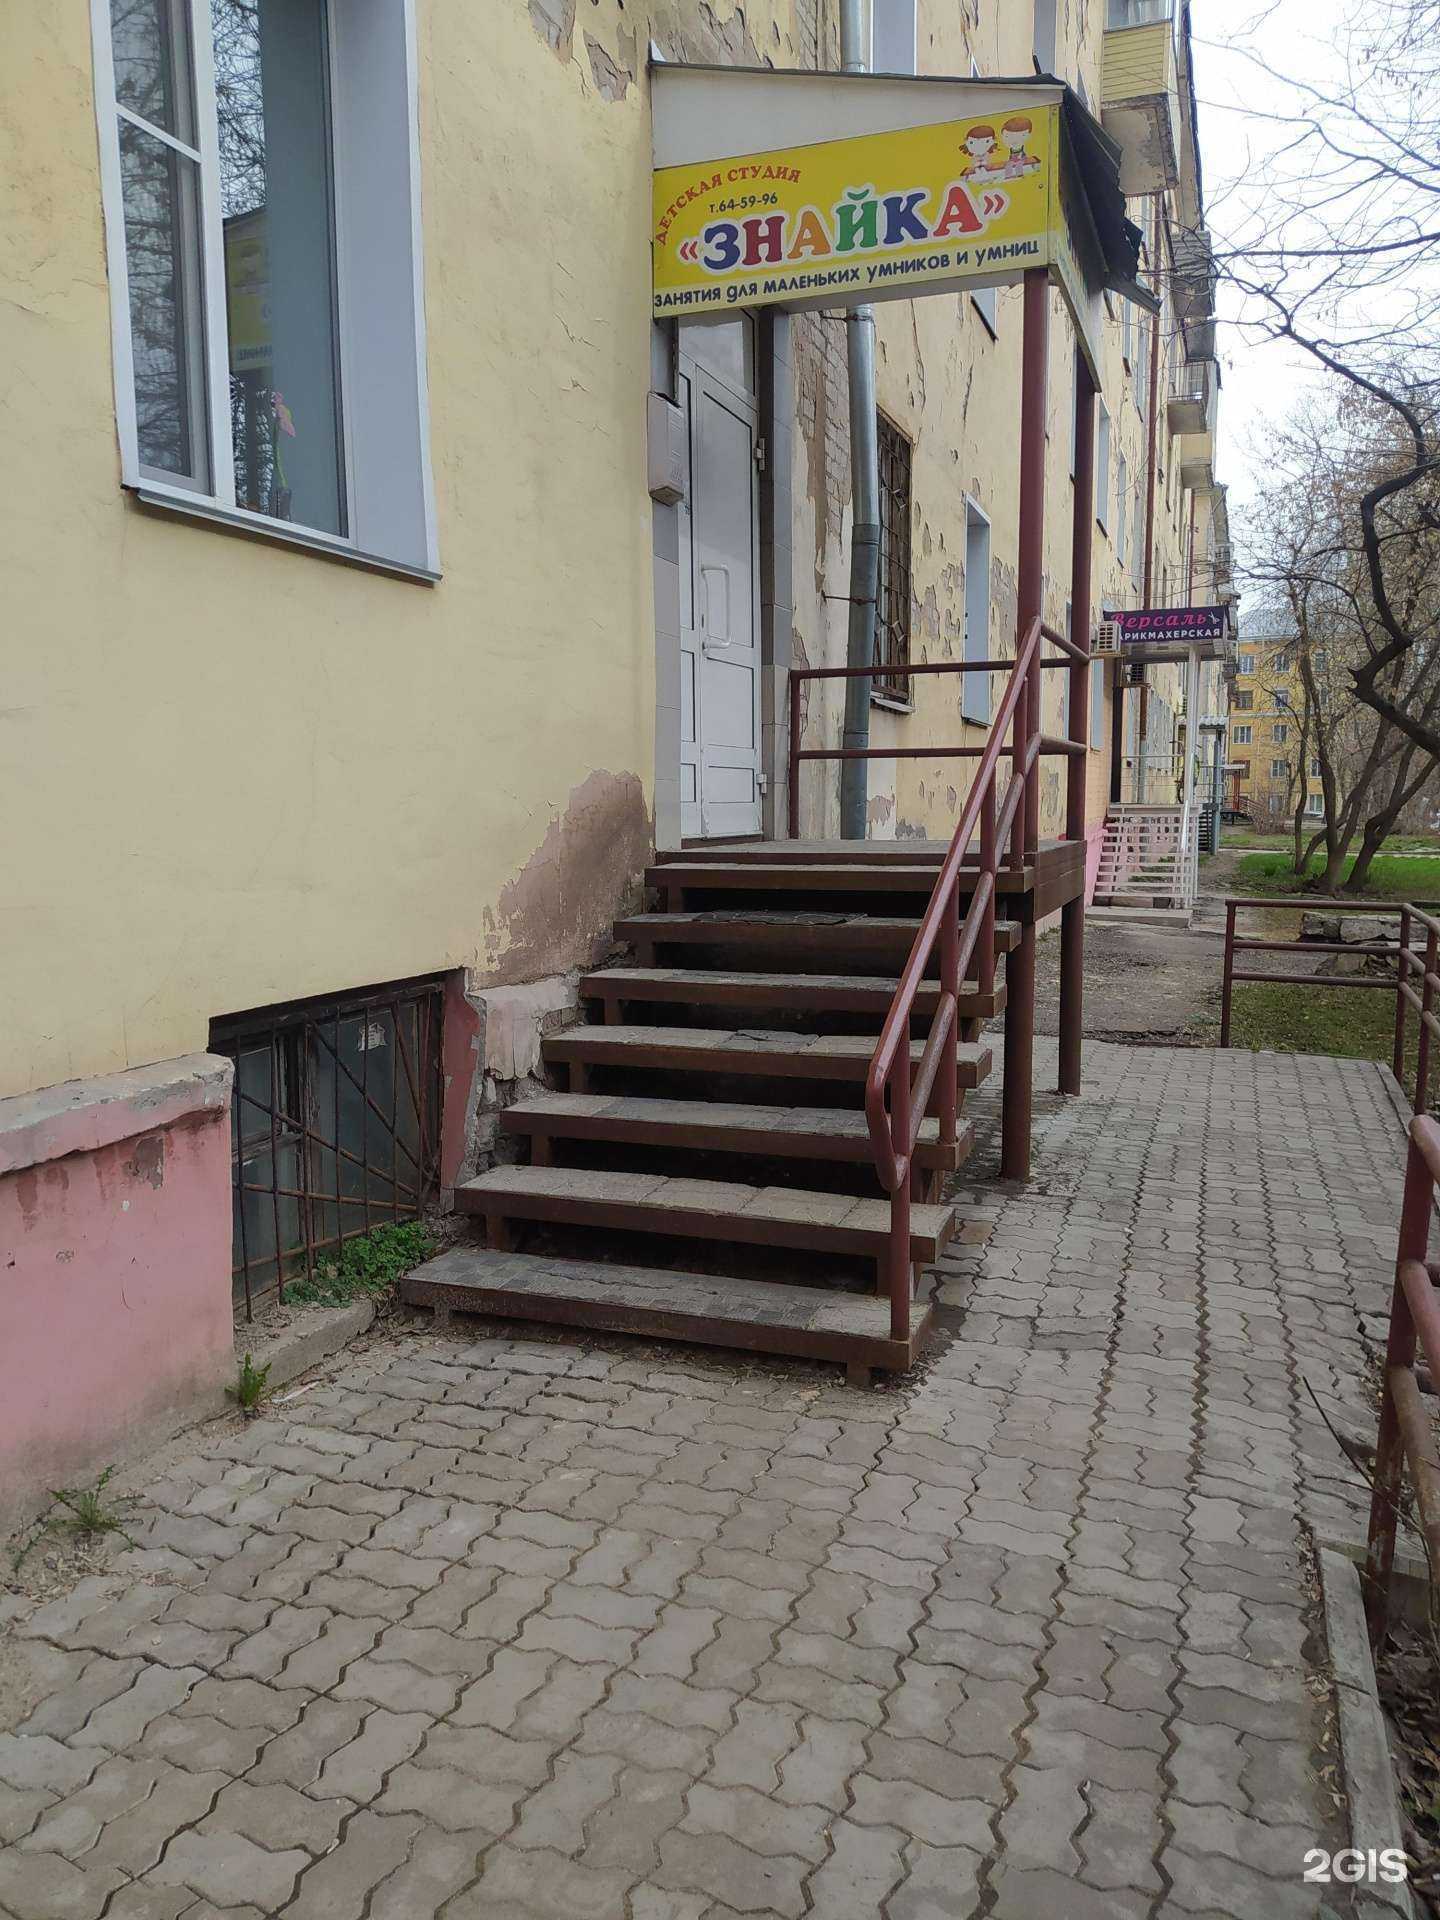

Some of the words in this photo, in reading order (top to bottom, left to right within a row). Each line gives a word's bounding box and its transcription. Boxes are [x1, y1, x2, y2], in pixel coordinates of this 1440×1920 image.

[655, 173, 723, 246] ДЕТСКАЯ
[727, 165, 802, 184] СТУДИЯ
[679, 186, 1006, 270] «ЗНАЙКА»
[654, 286, 722, 308] ЗАНЯТИЯ
[763, 266, 861, 294] МАЛЕНЬКИХ
[866, 254, 951, 284] УМНИКОВ
[956, 250, 969, 266] И
[975, 239, 1040, 268] УМНИЦ
[1111, 612, 1206, 629] Версаль
[1119, 628, 1221, 641] РИКМАХЕРСКАЯ
